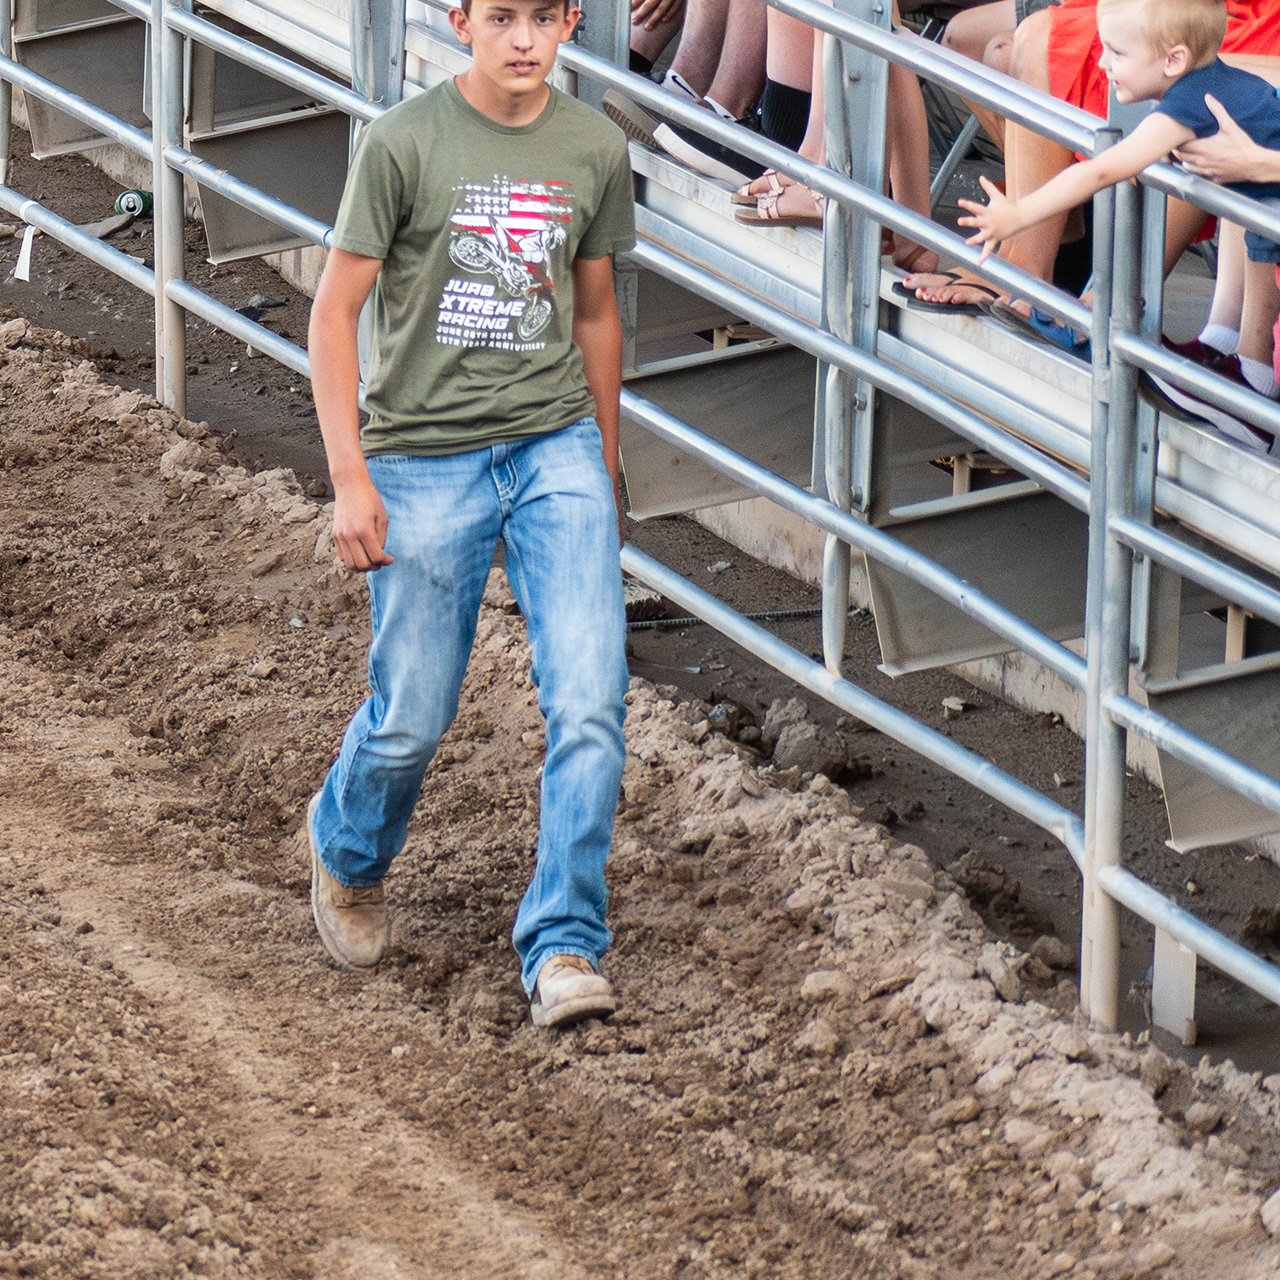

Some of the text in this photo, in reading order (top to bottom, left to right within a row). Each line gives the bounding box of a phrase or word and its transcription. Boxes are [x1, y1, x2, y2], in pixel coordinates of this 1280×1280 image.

[444, 279, 496, 297] JUAB
[439, 294, 526, 317] XTREME
[438, 311, 509, 330] RACING
[436, 325, 461, 336] JUNE
